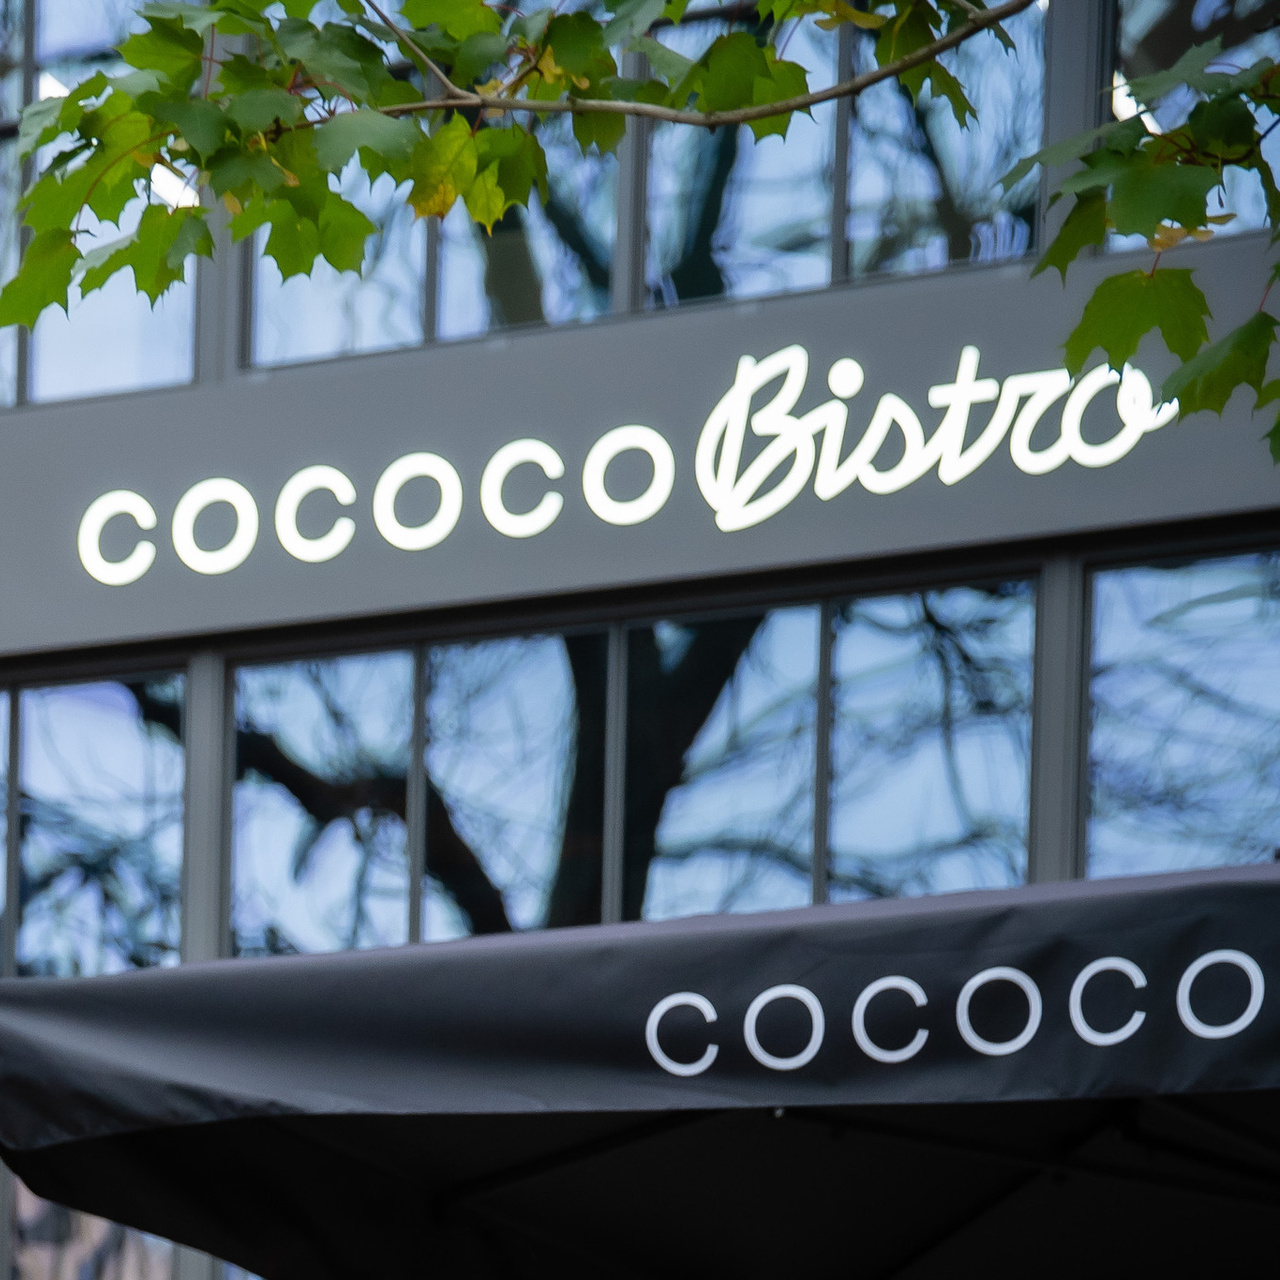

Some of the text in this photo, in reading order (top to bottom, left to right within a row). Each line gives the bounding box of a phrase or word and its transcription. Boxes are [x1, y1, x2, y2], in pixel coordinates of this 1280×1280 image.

[76, 343, 1179, 586] COCOCO Bistro
[645, 949, 1265, 1077] COCOCO
